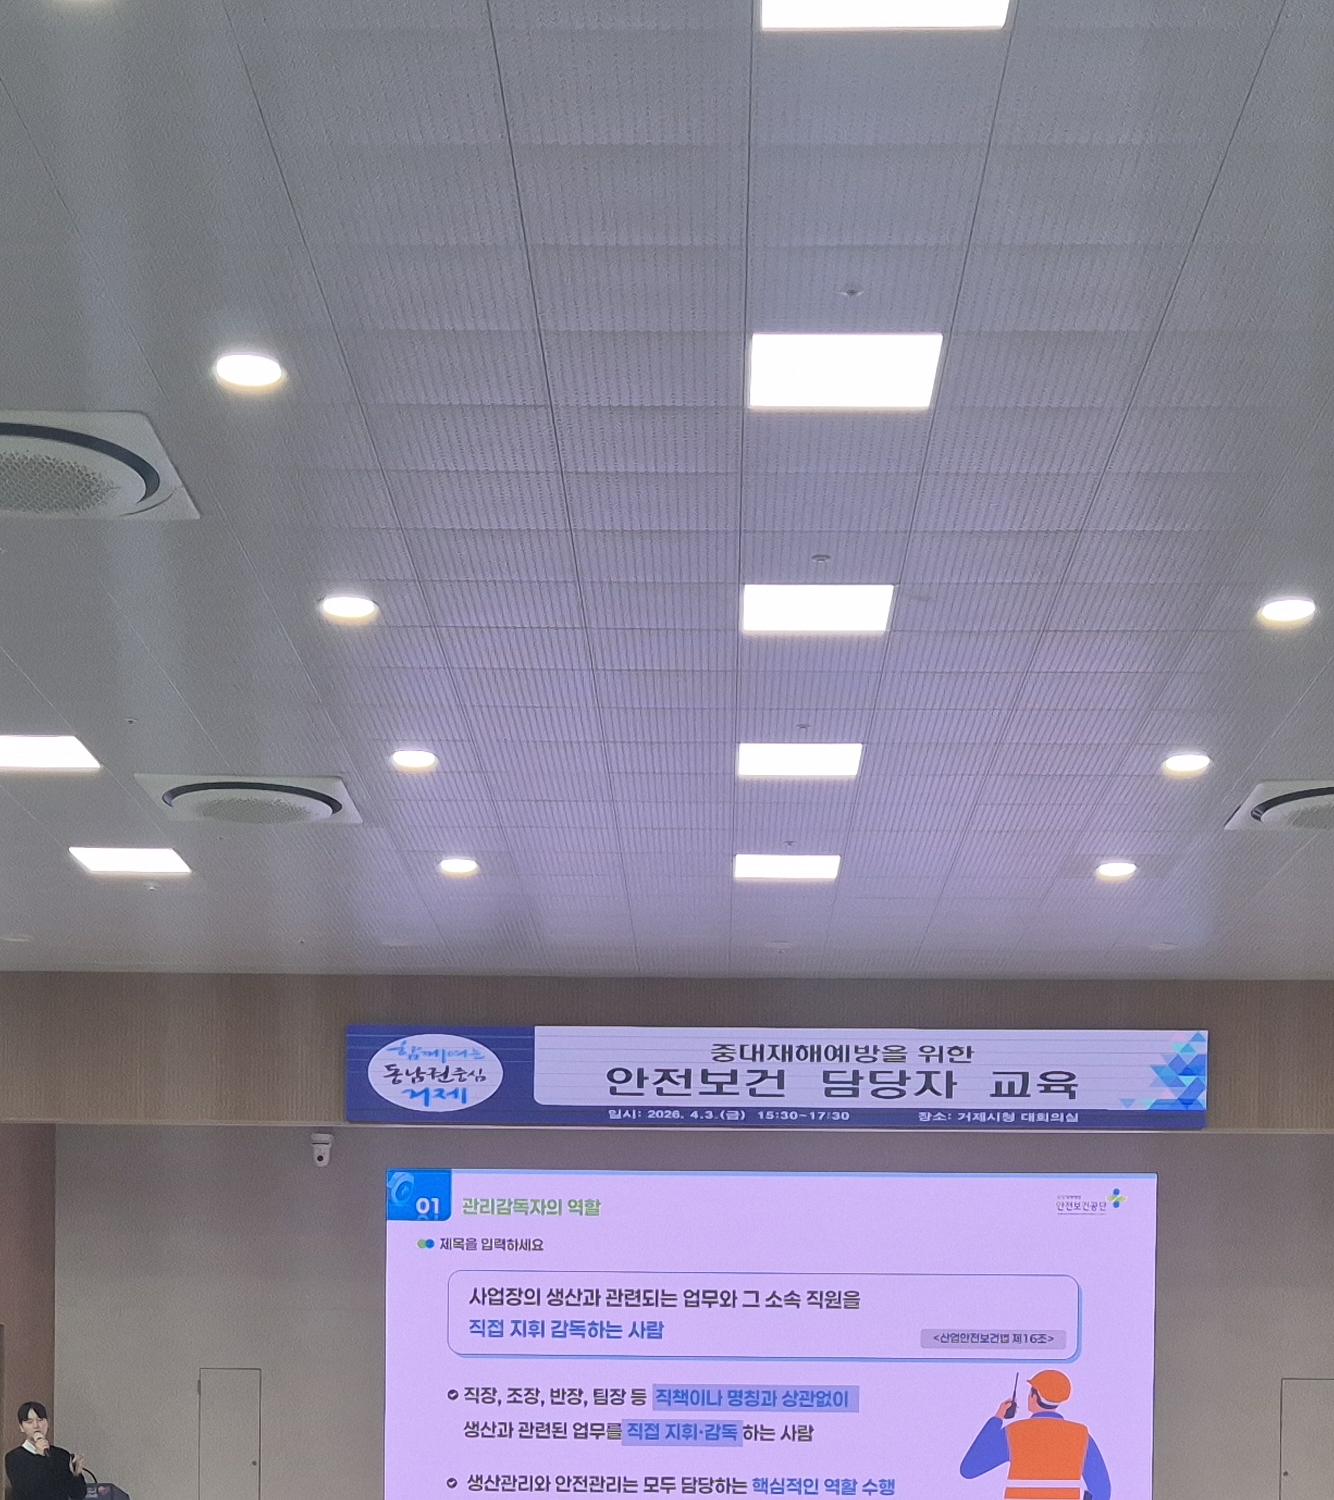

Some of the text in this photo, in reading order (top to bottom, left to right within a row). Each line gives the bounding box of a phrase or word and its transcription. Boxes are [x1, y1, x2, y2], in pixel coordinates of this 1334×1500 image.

[711, 1043, 974, 1064] 중대재해예방을 위한
[606, 1066, 1079, 1100] 안전보건 담당자 교육
[401, 1086, 468, 1107] 거제
[608, 1109, 642, 1120] 일시:
[647, 1109, 685, 1120] 2026.
[757, 1110, 850, 1122] 15:30~17:30
[918, 1111, 1079, 1124] 장소: 거제시청 대회의실
[416, 1197, 440, 1214] 01
[462, 1197, 601, 1217] 관리감독자의 역할
[1056, 1201, 1107, 1212] 안전보건공단
[439, 1237, 544, 1252] 제목을 입력하세요
[469, 1287, 861, 1310] 사업장의 생산과 관련되는 업무와 그 소속 직원을
[469, 1318, 665, 1340] 직접 지휘 감독하는 사람
[933, 1332, 1055, 1345] <산업안전보건법 제16조>
[463, 1387, 849, 1408] 직장, 조장, 반장, 팀장 등 직책이나 명칭과 상관없이
[463, 1421, 514, 1440] 생산과
[518, 1421, 568, 1440] 관련된
[572, 1422, 623, 1441] 업무를
[627, 1422, 661, 1441] 직접
[780, 1424, 815, 1443] 사람
[467, 1474, 896, 1496] 생산관리와 안전관리는 모두 담당하는 핵심적인 역할 수행
